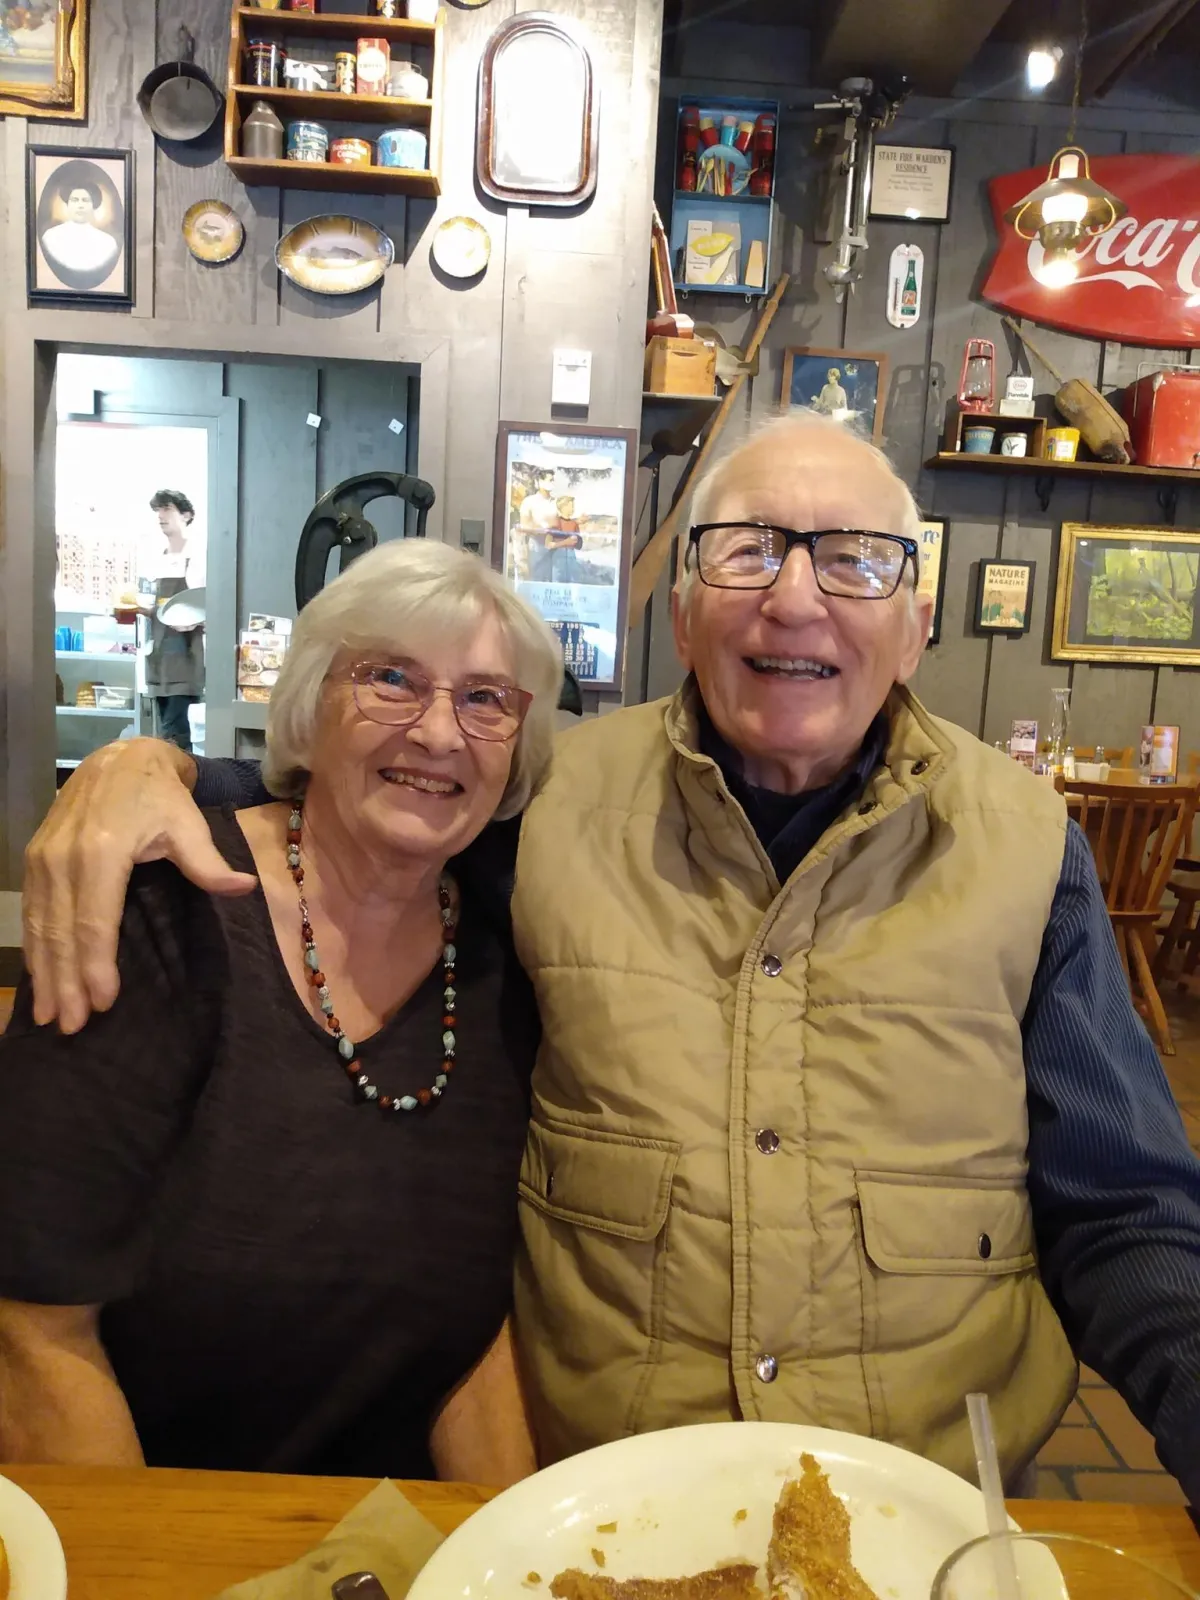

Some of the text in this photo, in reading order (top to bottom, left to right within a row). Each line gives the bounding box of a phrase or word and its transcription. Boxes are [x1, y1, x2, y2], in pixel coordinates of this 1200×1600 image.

[878, 151, 897, 161] STATE
[900, 152, 913, 162] FIRE
[895, 163, 928, 174] RESIDENCE
[564, 436, 622, 450] AMERICA
[989, 568, 1026, 579] NATURE
[988, 578, 1025, 586] MAGAZINE
